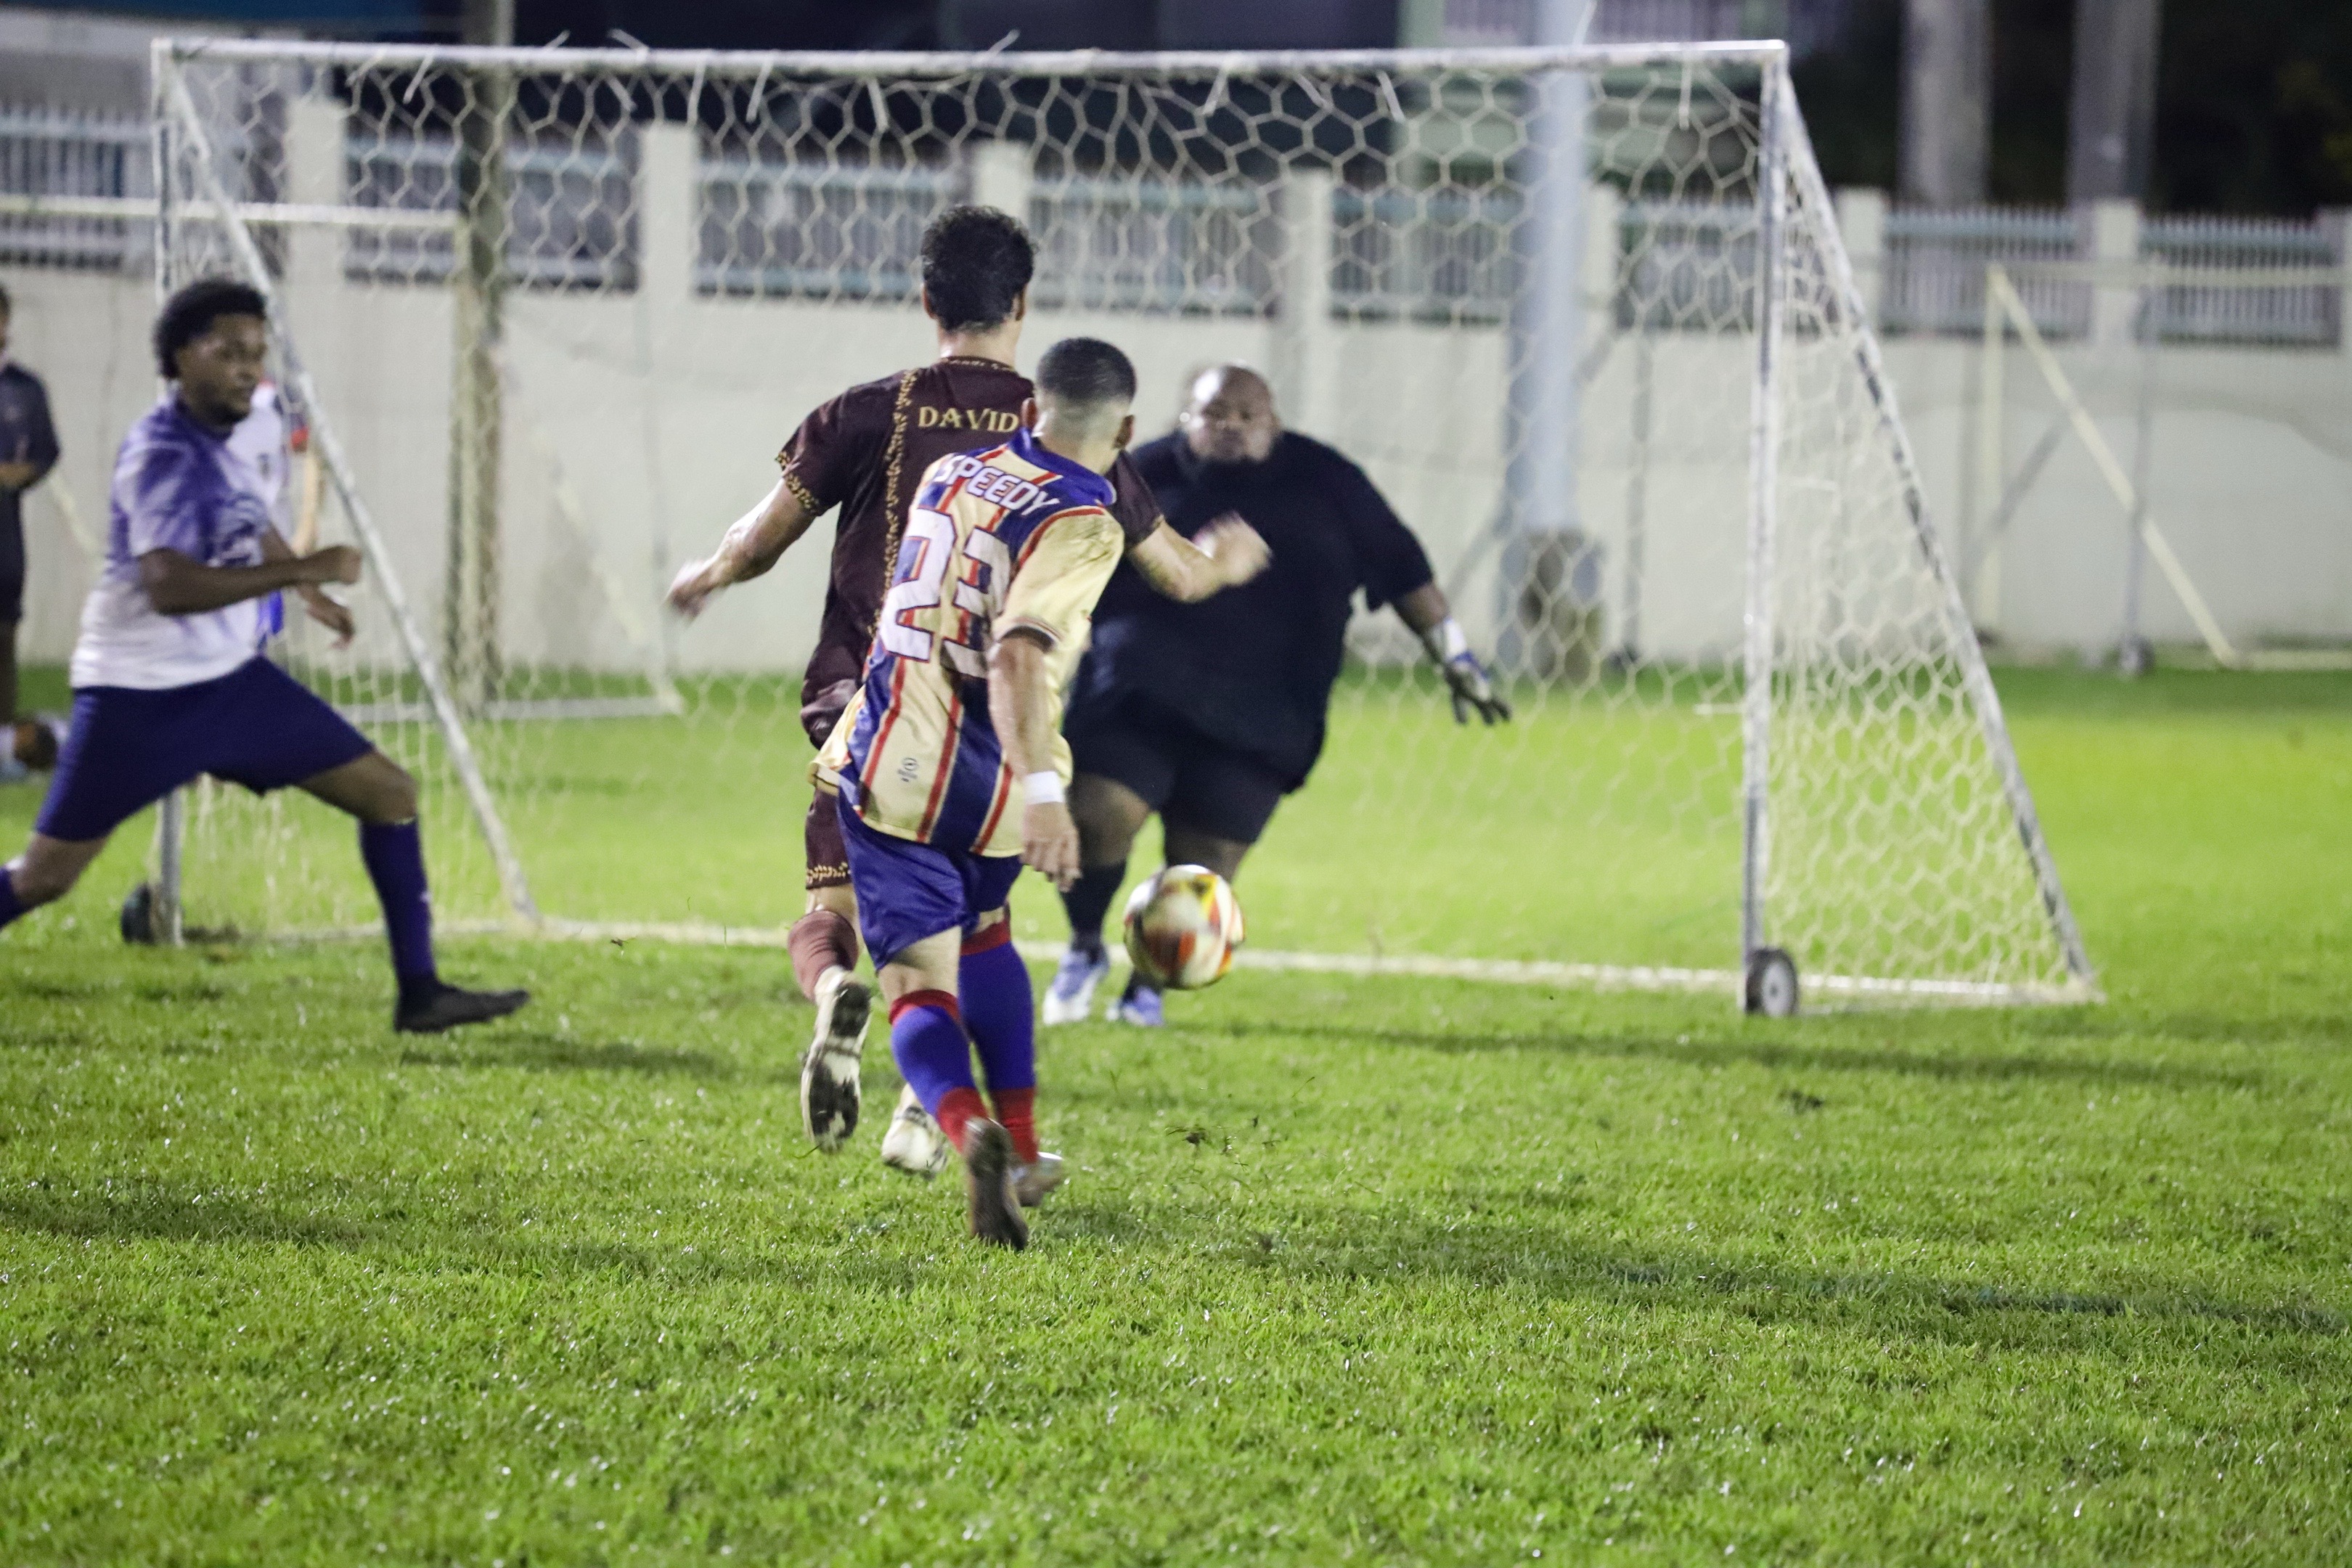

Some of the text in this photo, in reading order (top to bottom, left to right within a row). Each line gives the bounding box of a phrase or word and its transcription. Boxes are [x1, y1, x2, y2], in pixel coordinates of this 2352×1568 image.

[918, 406, 1019, 433] DAVID
[933, 454, 1060, 515] SPEEDY
[879, 507, 1011, 679] 23
